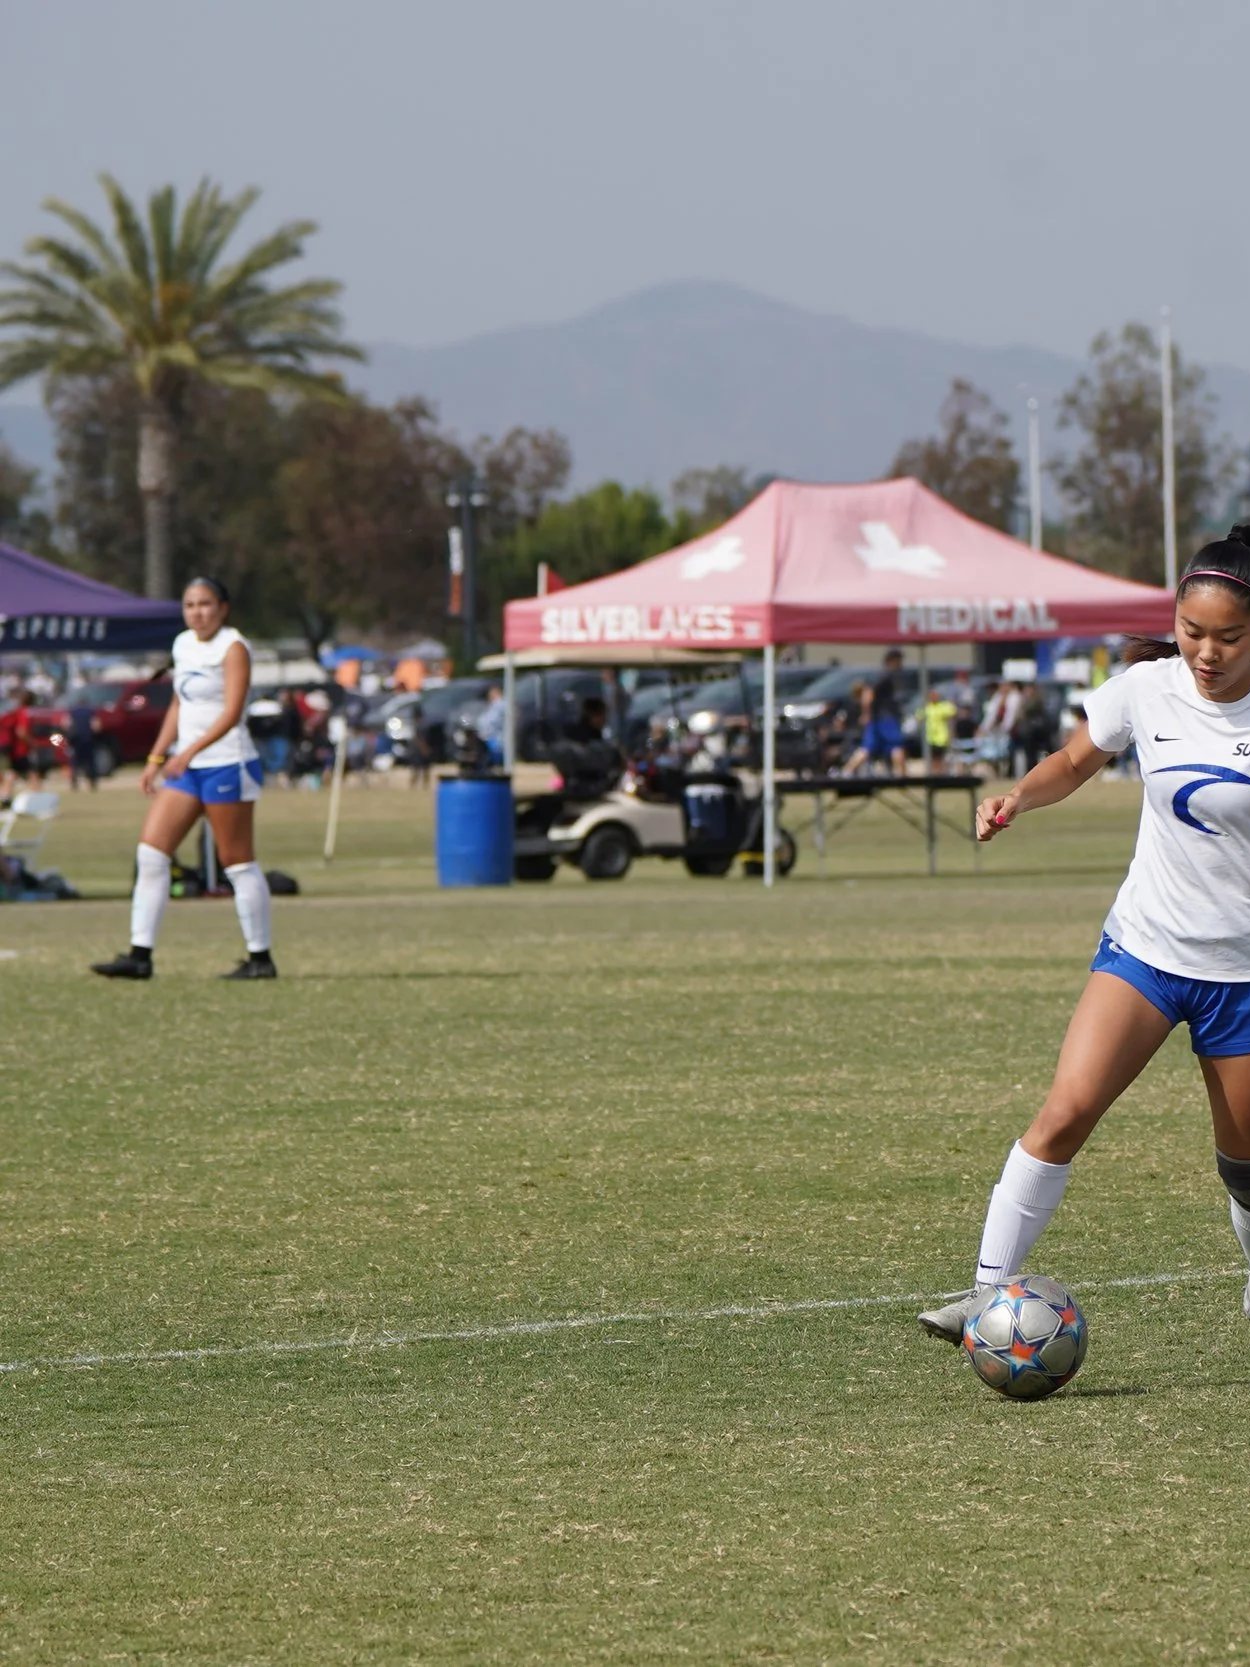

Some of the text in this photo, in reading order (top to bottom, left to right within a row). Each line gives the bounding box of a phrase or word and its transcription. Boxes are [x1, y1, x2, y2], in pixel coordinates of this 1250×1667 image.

[14, 616, 106, 640] SPORTS
[541, 604, 735, 642] SILVERLAKES
[897, 598, 1058, 634] MEDICAL
